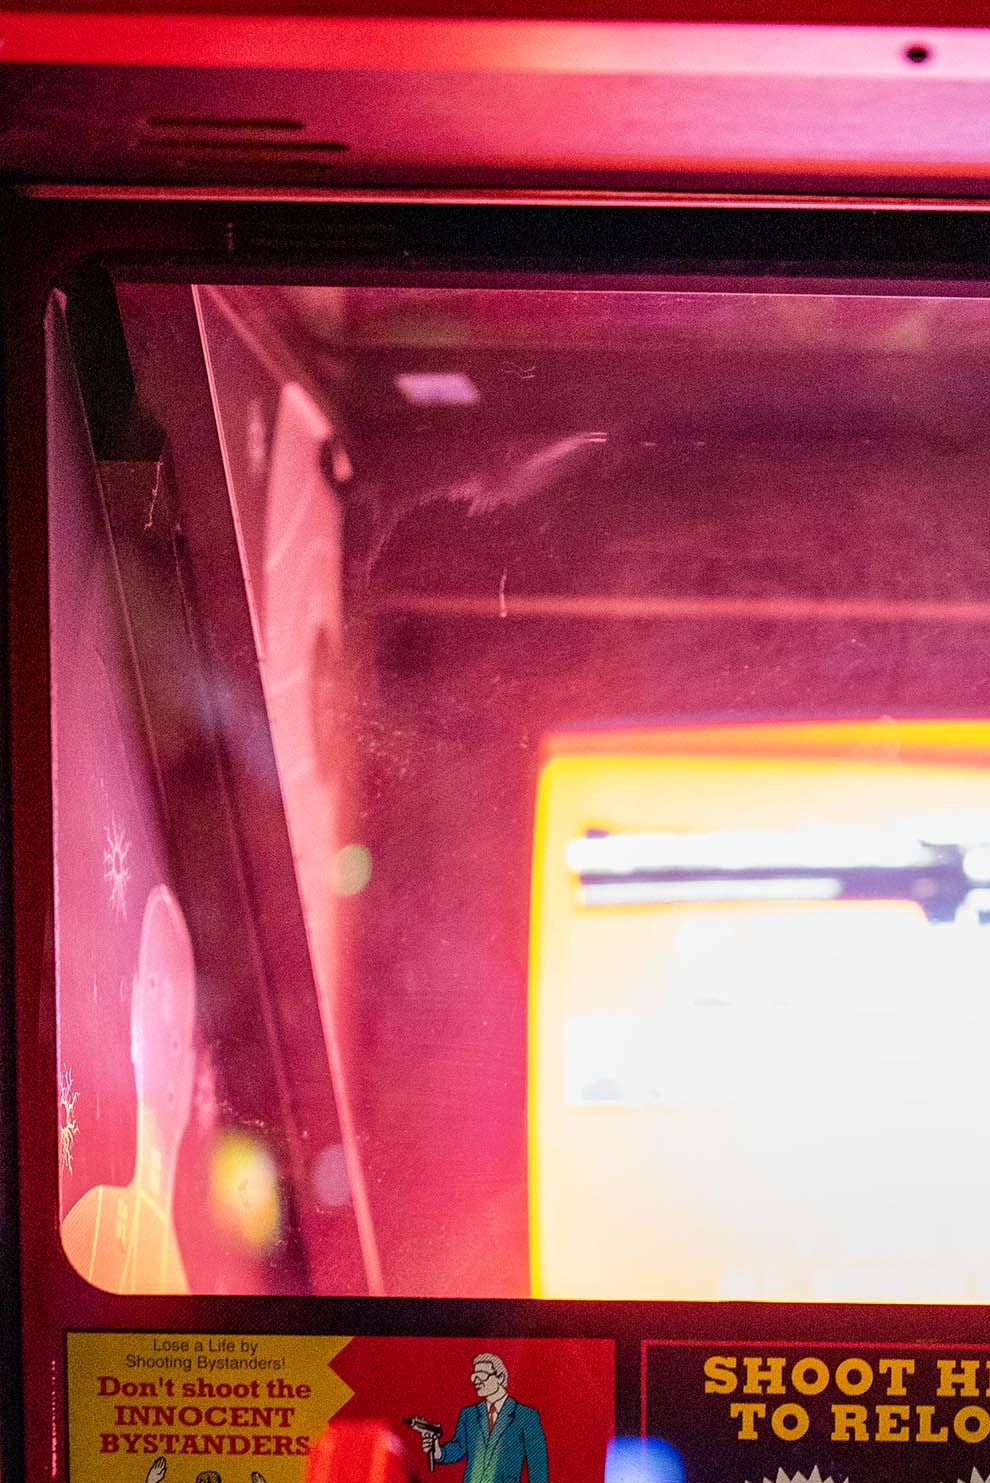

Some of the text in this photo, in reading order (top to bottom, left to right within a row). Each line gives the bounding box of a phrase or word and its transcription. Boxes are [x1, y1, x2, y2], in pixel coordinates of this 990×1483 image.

[153, 1339, 258, 1355] Lose a Life by
[125, 1354, 286, 1372] Shooting Bystanders!
[704, 1356, 915, 1396] SHOOT
[97, 1377, 312, 1399] Don't shoot the
[114, 1406, 295, 1428] INNOCENT
[730, 1403, 810, 1441] TO
[100, 1434, 311, 1455] BYSTANDERS
